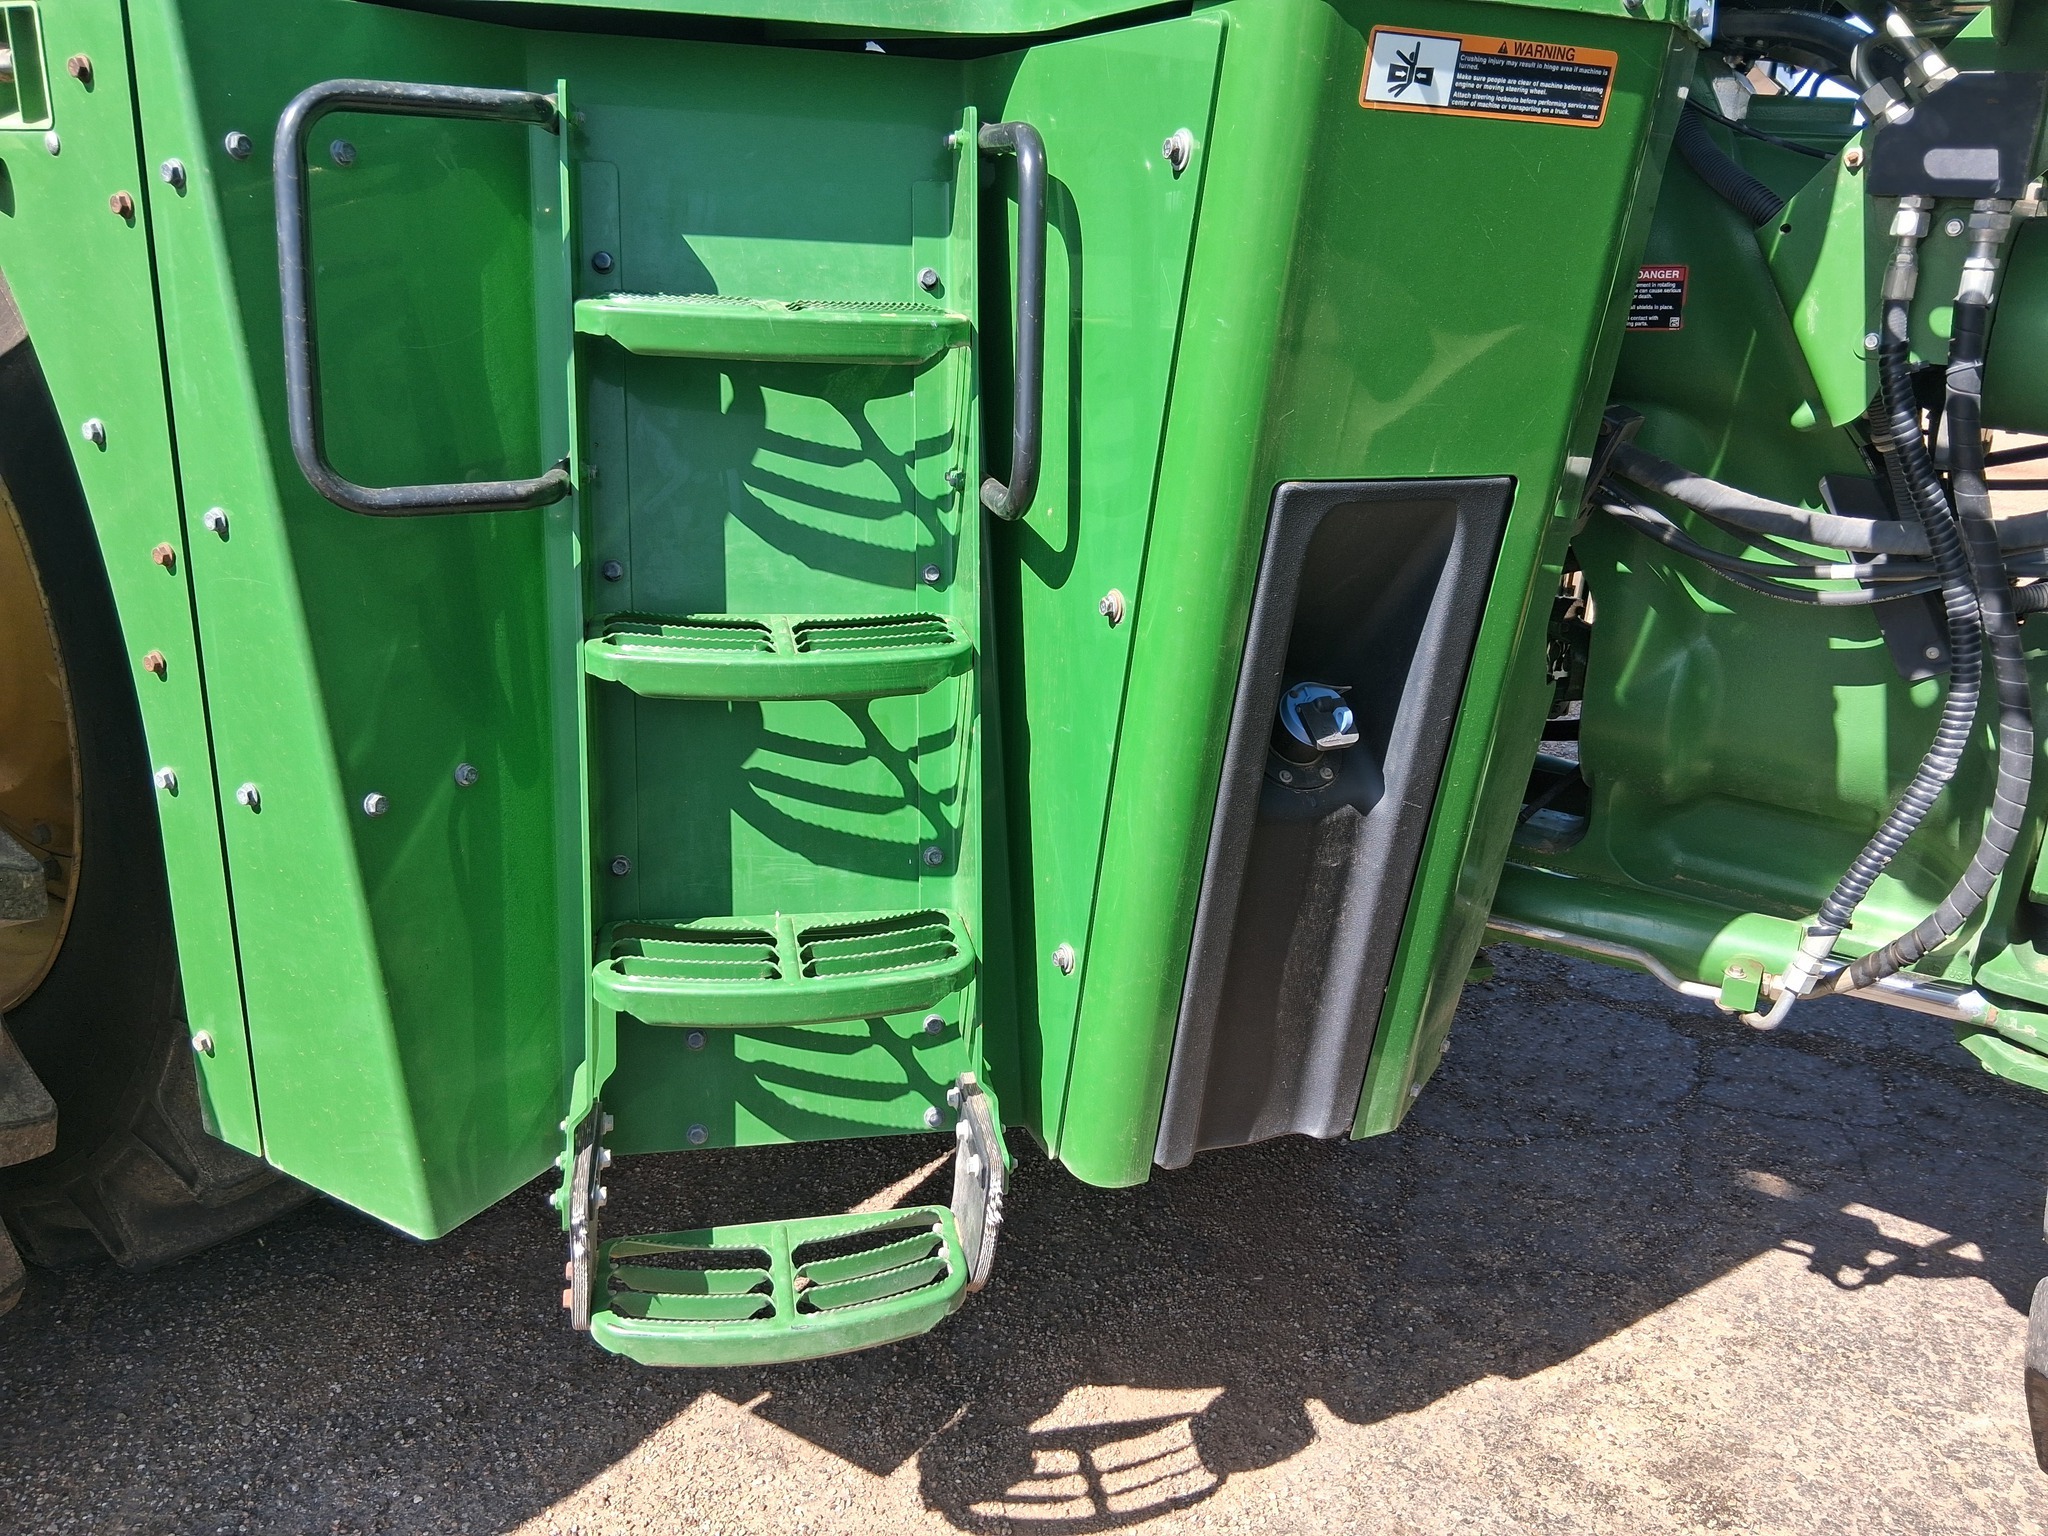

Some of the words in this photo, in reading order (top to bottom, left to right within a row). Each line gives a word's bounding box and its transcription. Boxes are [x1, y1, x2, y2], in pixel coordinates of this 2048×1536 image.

[1514, 41, 1576, 62] WARNING
[1459, 62, 1480, 71] turned.
[1460, 54, 1487, 65] Crushing
[1488, 57, 1505, 67] injury
[1506, 60, 1518, 68] may
[1519, 61, 1536, 69] result
[1544, 63, 1560, 72] hinge
[1579, 67, 1602, 76] machine
[1455, 81, 1475, 90] engine
[1483, 83, 1505, 92] moving
[1505, 86, 1529, 95] steering
[1529, 87, 1547, 95] wheel.
[1456, 72, 1472, 81] Make
[1487, 76, 1507, 85] people
[1540, 81, 1564, 90] machine
[1564, 83, 1582, 92] before
[1582, 86, 1604, 95] starting
[1451, 99, 1469, 107] center
[1477, 101, 1501, 109] machine
[1508, 104, 1542, 114] transporting
[1555, 108, 1570, 116] truck.
[1453, 91, 1472, 99] Attach
[1472, 93, 1495, 102] steering
[1495, 95, 1519, 103] lockouts
[1520, 97, 1537, 105] before
[1537, 99, 1567, 109] performing
[1568, 102, 1587, 110] service
[1638, 270, 1679, 279] DANGER
